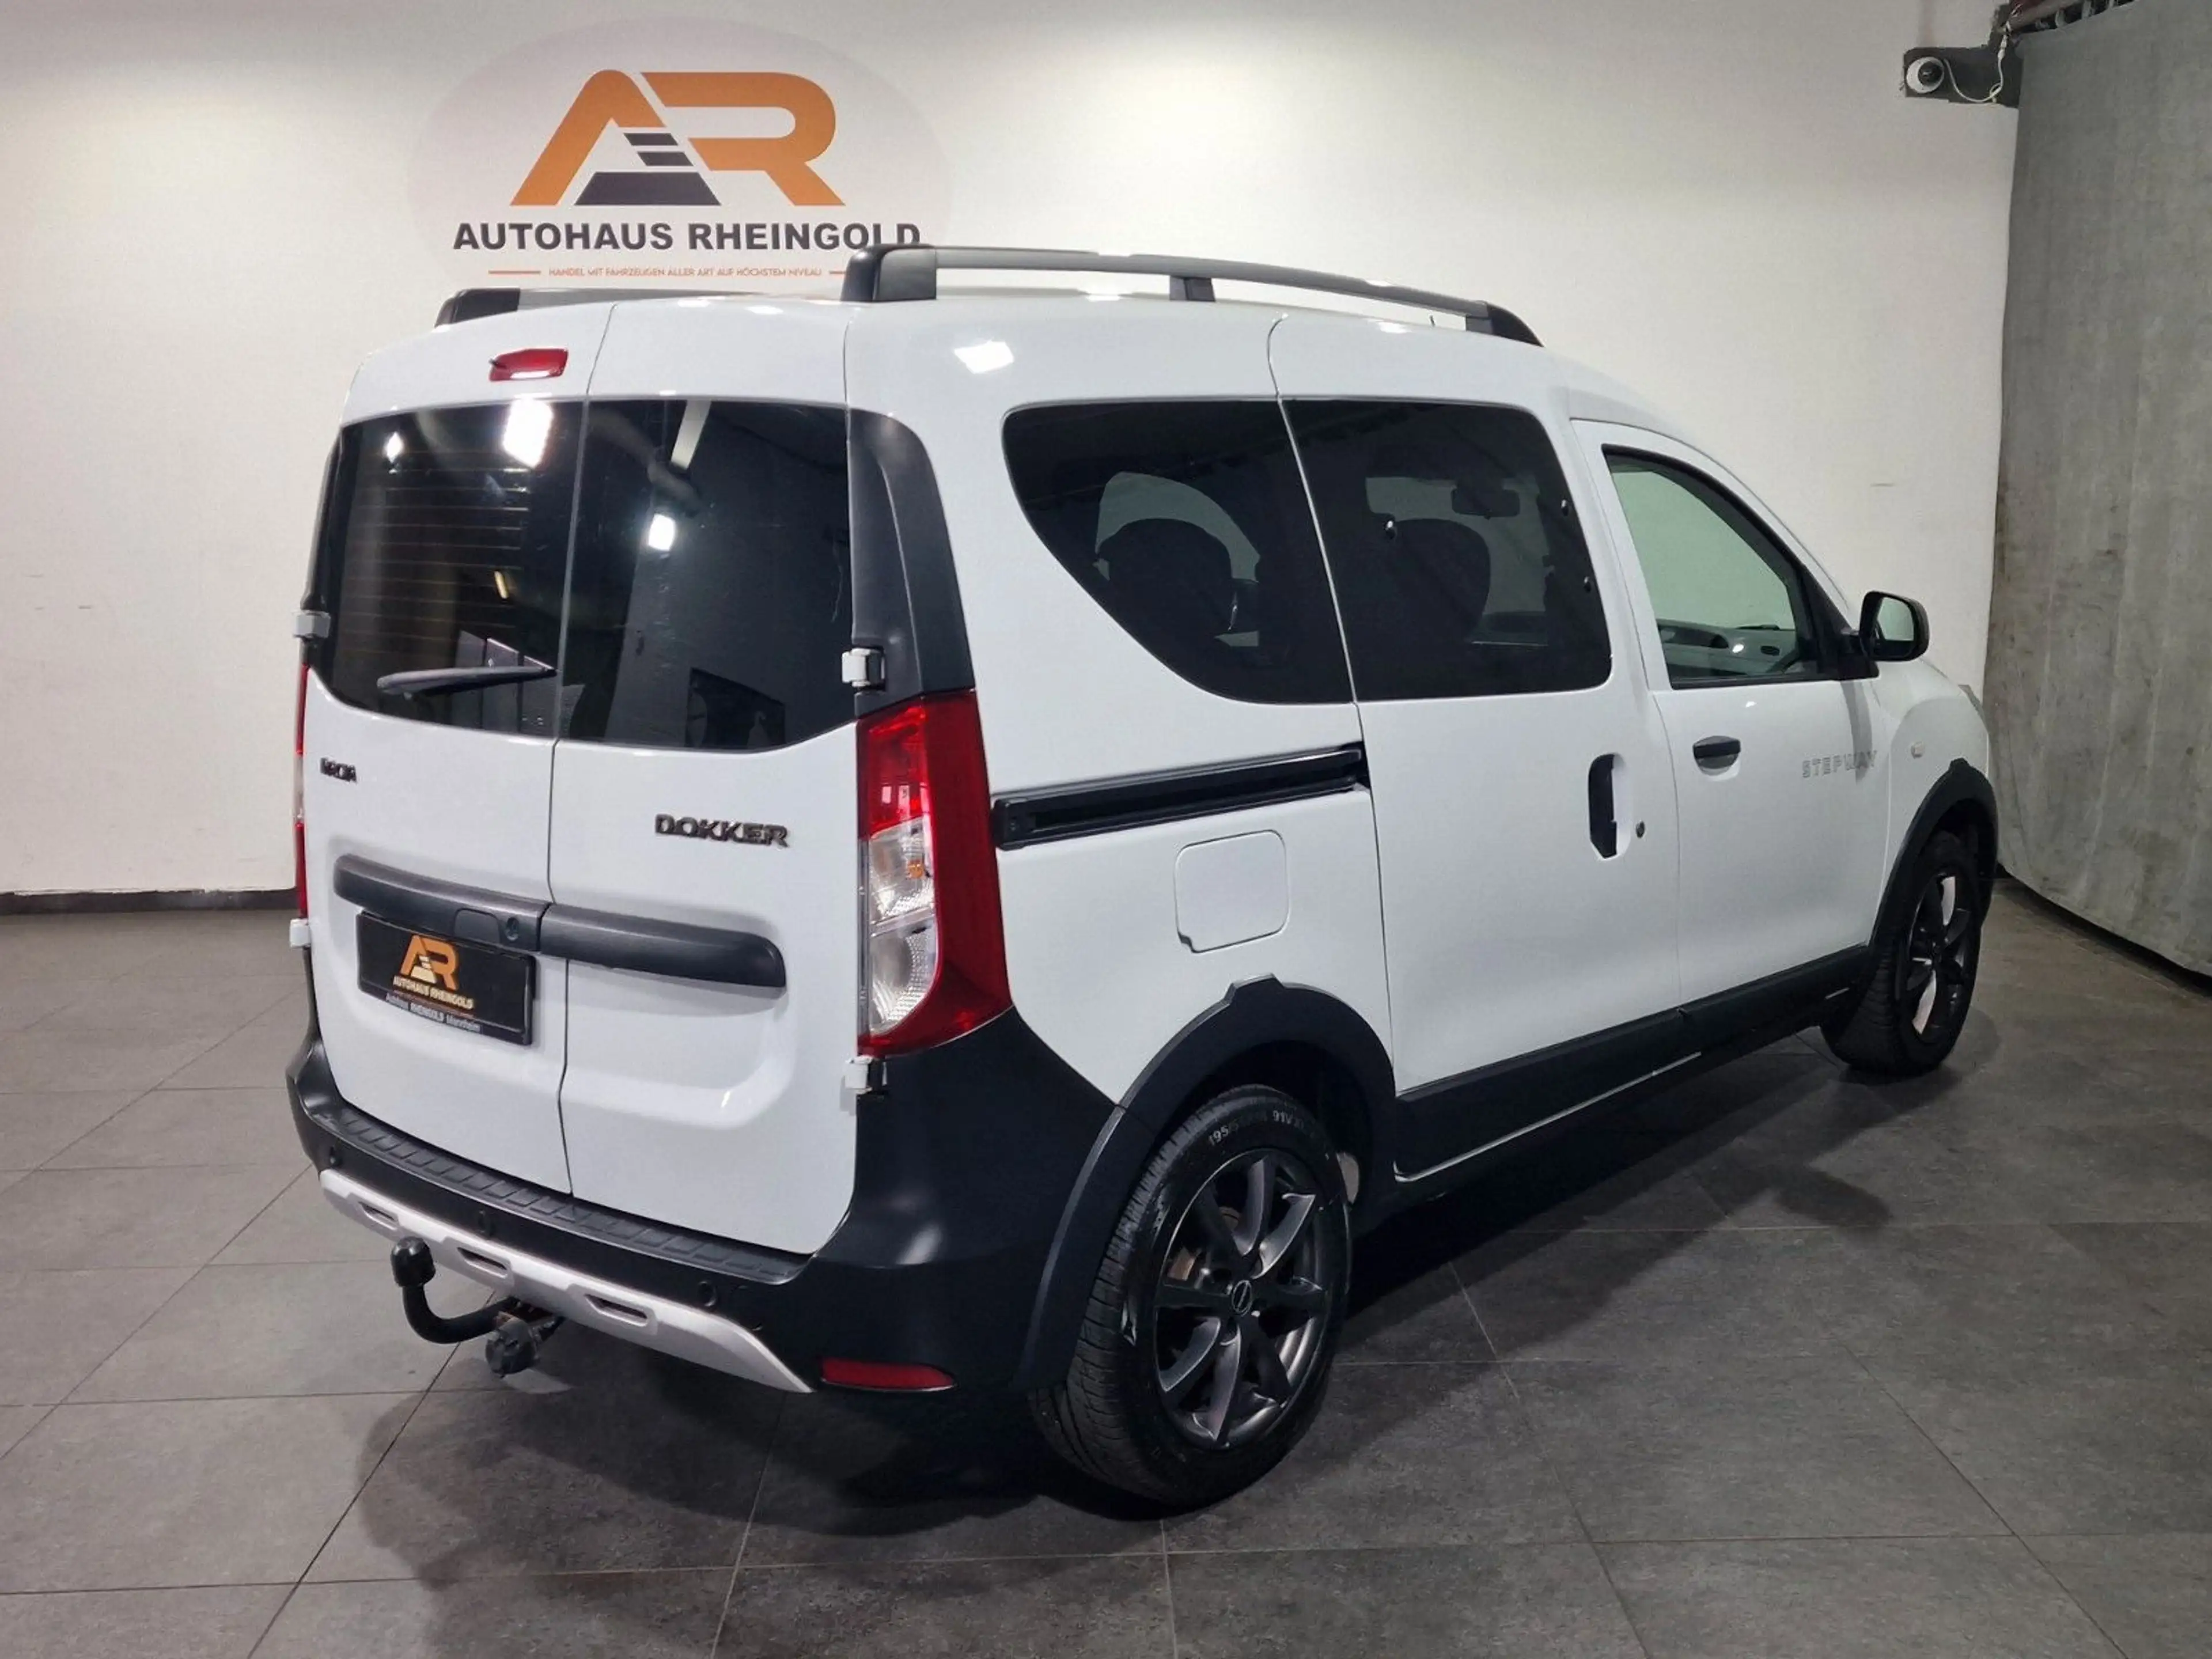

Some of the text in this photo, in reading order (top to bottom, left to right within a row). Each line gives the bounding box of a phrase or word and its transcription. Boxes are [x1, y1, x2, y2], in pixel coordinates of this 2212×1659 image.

[453, 222, 921, 250] AUTOHAUS RHEINGOLD
[549, 267, 585, 278] HANDEL
[588, 267, 604, 278] MIT
[605, 267, 665, 278] FAHRZEUGEN
[667, 267, 695, 278] ALLER
[697, 267, 714, 278] ART
[717, 267, 734, 278] AUF
[789, 267, 822, 278] NIVEAU
[654, 813, 790, 847] DOKKER
